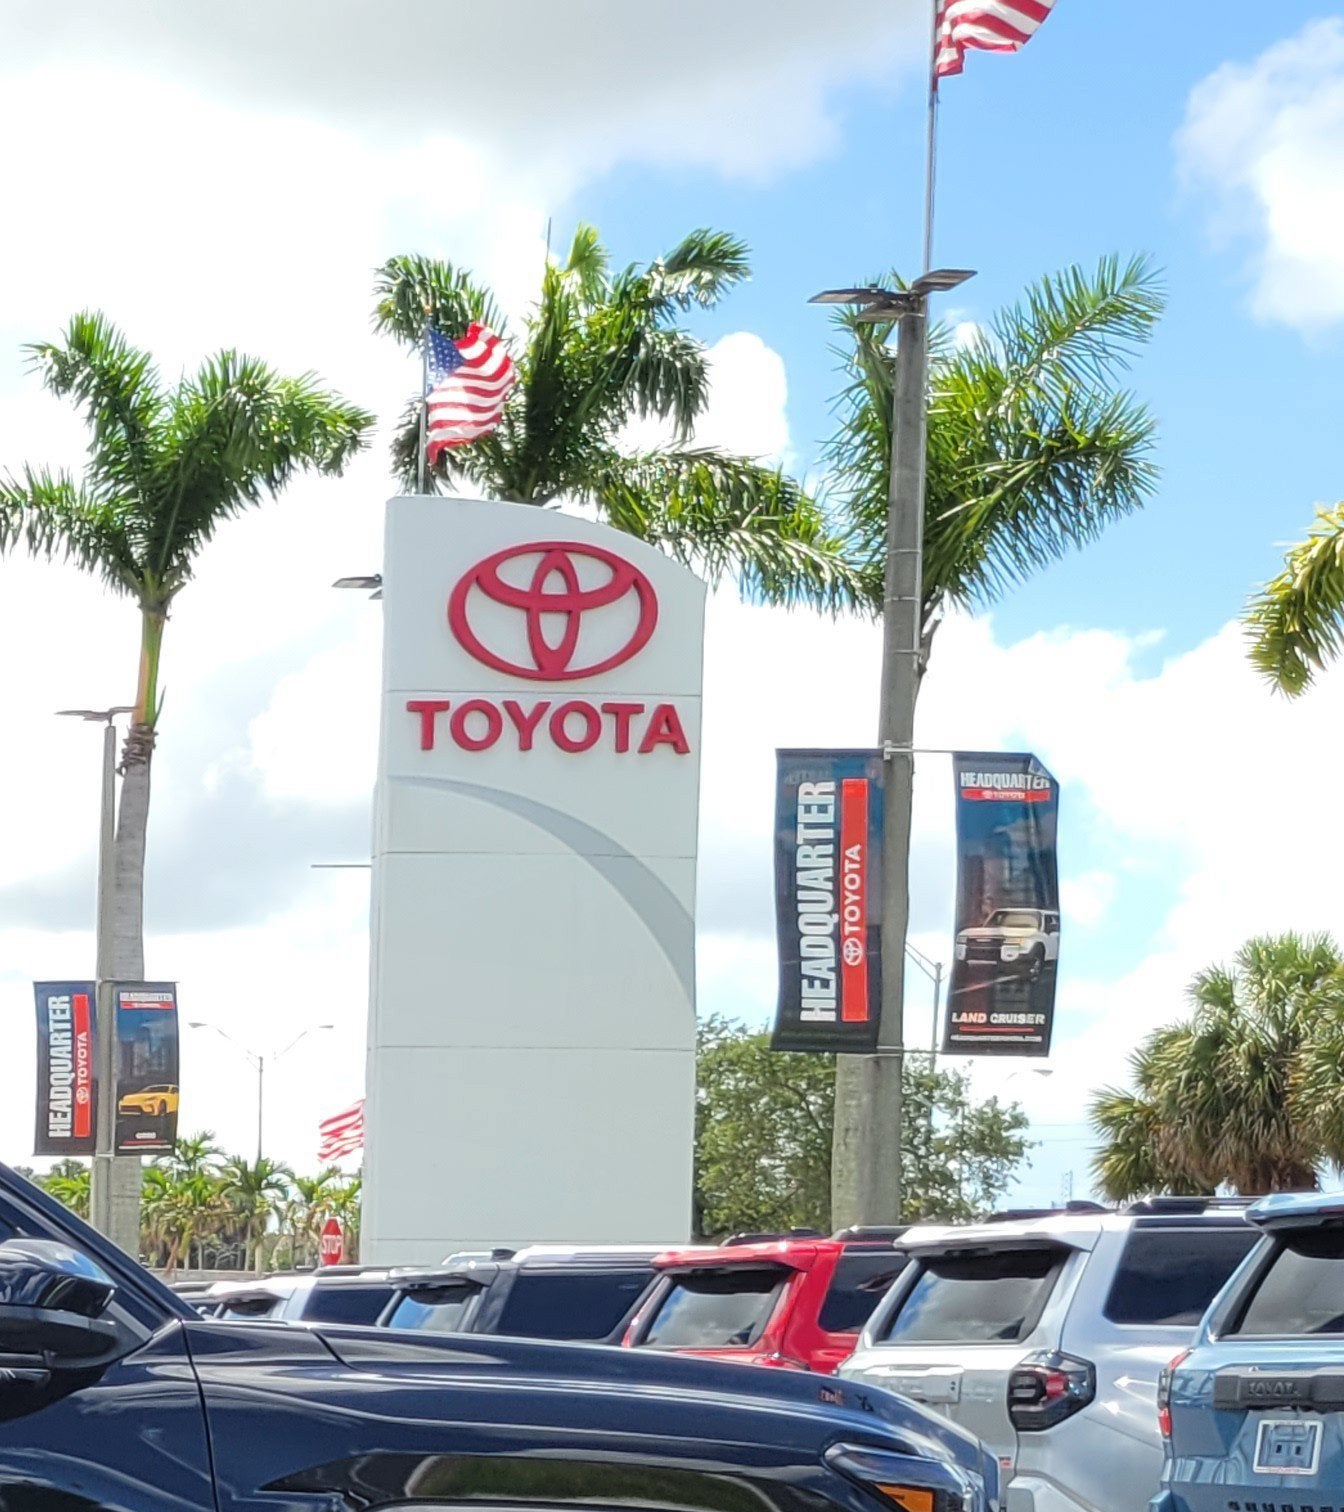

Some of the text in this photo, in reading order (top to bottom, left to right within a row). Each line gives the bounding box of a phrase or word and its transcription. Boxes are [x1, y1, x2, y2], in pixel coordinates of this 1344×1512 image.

[406, 699, 691, 754] TOYOTA
[960, 771, 1050, 790] HEADQUARTER
[796, 781, 839, 1022] HEADQUARTER
[842, 844, 862, 935] TOYOTA
[951, 1012, 1046, 1025] LAND CRUISER
[48, 995, 75, 1138] HEADQUARTER
[77, 1031, 88, 1085] TOYOTA
[321, 1234, 342, 1255] STOP
